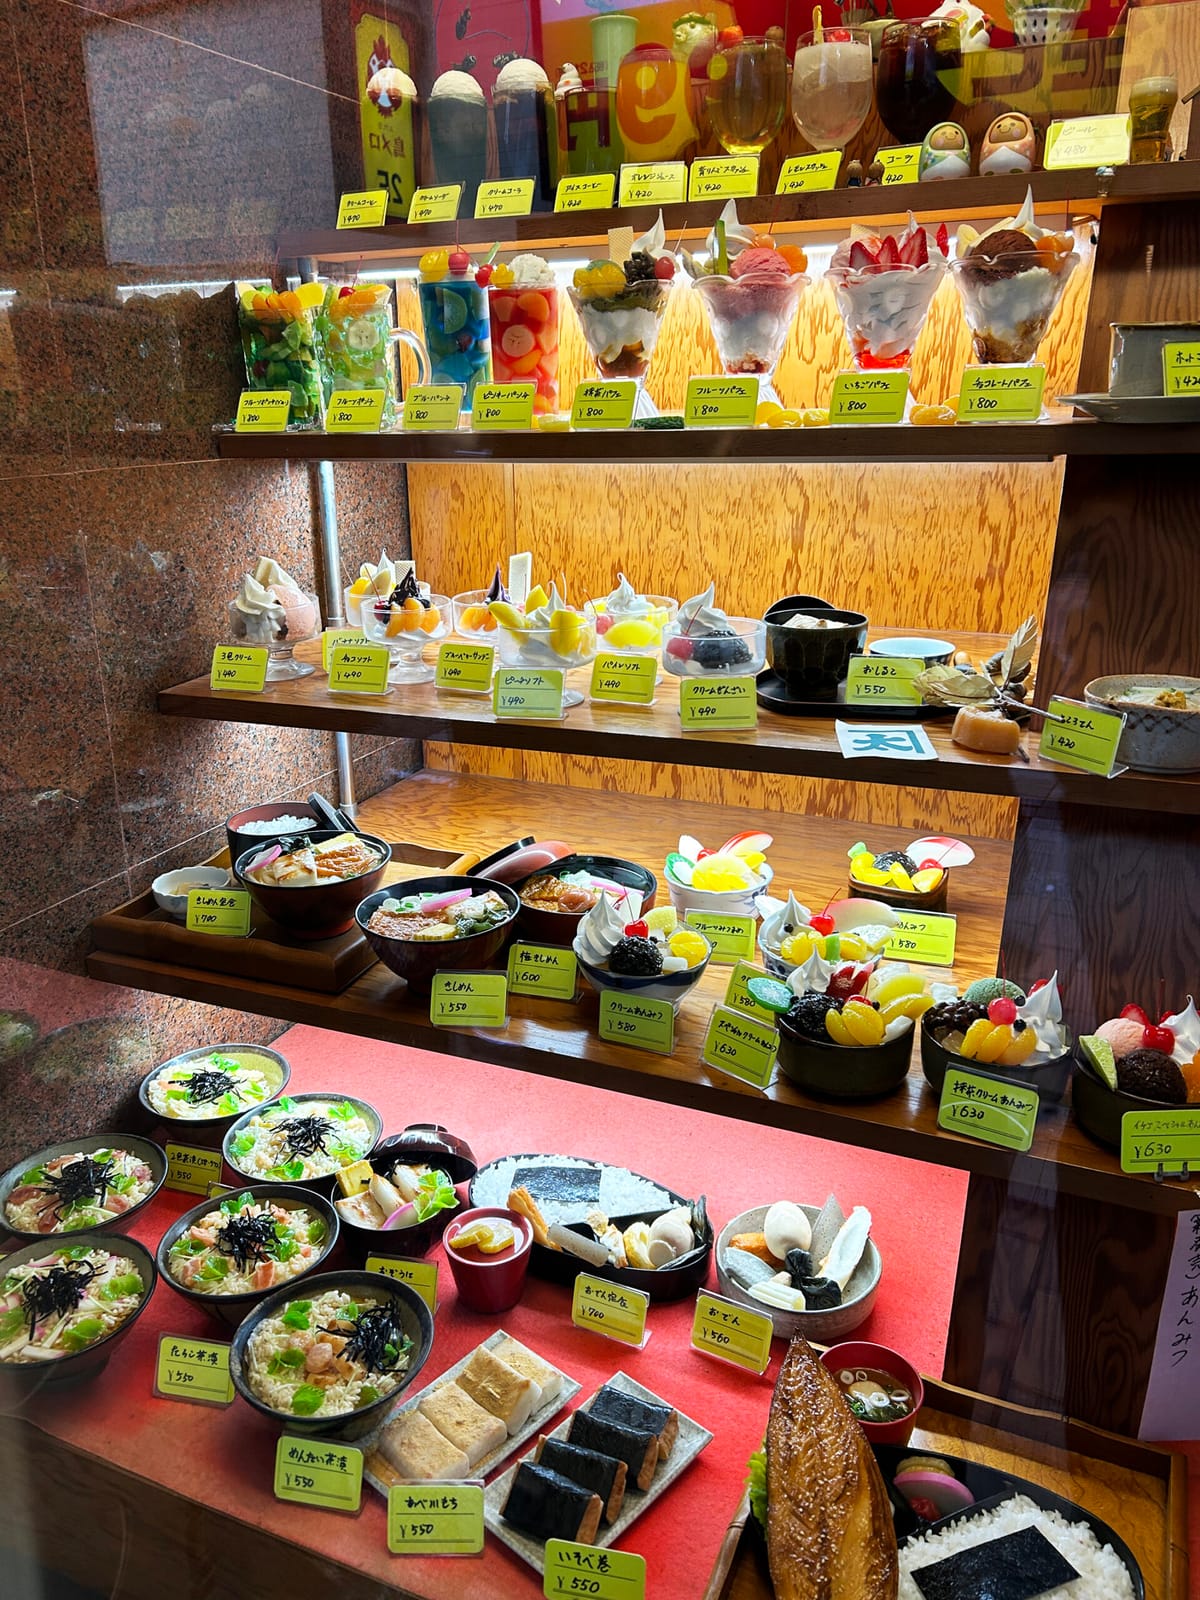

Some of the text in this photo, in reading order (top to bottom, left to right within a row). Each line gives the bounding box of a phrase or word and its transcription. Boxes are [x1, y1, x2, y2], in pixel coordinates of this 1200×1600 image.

[698, 183, 721, 193] ¥420
[629, 190, 652, 199] ¥420
[844, 379, 890, 391] いちごパフェ
[972, 377, 1032, 389] チョコレートパフェ
[583, 387, 622, 399] 抹茶パフェ
[696, 385, 747, 396] フルーツパフェ
[838, 400, 867, 412] ¥800
[968, 397, 998, 410] ¥800
[410, 410, 429, 420] ¥800
[478, 408, 501, 419] ¥800
[579, 407, 604, 418] ¥800
[693, 404, 719, 416] ¥800
[333, 412, 352, 422] ¥800
[220, 651, 253, 661] 3色クリーム
[602, 661, 640, 671] パインソフト
[863, 665, 897, 676] おしるこ
[599, 679, 621, 689] ¥490
[856, 684, 886, 695] ¥550
[692, 685, 746, 696] クリームぜんざい
[501, 695, 525, 706] ¥490
[690, 706, 716, 717] ¥490
[1050, 734, 1076, 749] ¥420
[195, 914, 217, 924] ¥700
[890, 937, 917, 949] ¥580
[520, 951, 558, 965] 梅きしめん
[515, 972, 540, 982] ¥600
[444, 981, 474, 993] きしめん
[732, 992, 756, 1007] ¥580
[440, 1003, 467, 1013] ¥550
[610, 1001, 663, 1020] クリームあんみつ
[608, 1019, 636, 1032] ¥580
[714, 1040, 737, 1056] ¥630
[951, 1105, 985, 1120] ¥630
[1134, 1142, 1172, 1159] ¥630
[170, 1170, 192, 1180] ¥550
[379, 1265, 414, 1279] おぞうに
[581, 1305, 605, 1320] ¥700
[708, 1306, 740, 1326] おでん
[702, 1327, 730, 1344] ¥560
[168, 1369, 194, 1382] ¥550
[288, 1447, 348, 1472] めんたい茶漬
[285, 1473, 314, 1487] ¥550
[405, 1496, 458, 1509] あべ川もち
[400, 1524, 434, 1538] ¥550
[558, 1551, 612, 1573] いそべ巻
[557, 1576, 600, 1593] ¥550
